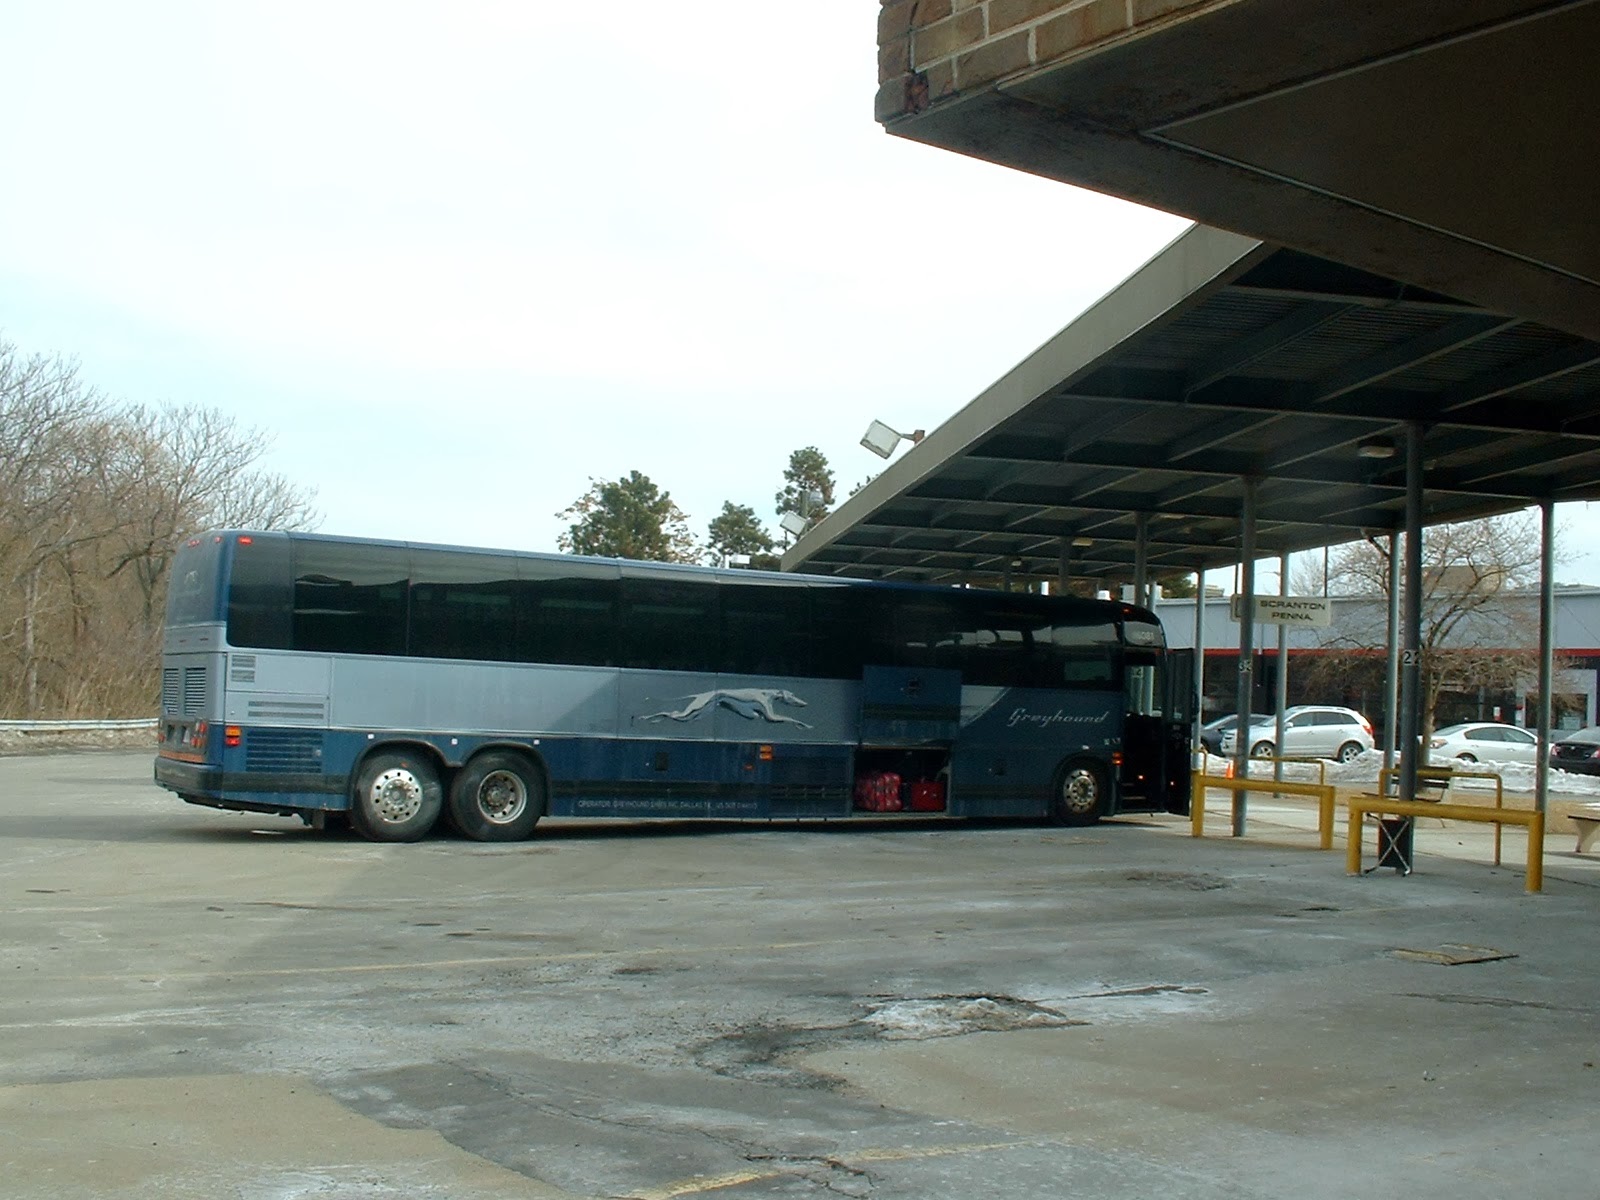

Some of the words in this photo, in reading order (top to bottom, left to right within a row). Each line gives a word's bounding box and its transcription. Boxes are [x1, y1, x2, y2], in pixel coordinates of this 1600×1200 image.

[1260, 600, 1326, 611] SCRANTON
[1271, 611, 1313, 621] PENNA.
[1005, 708, 1110, 728] Greyhound
